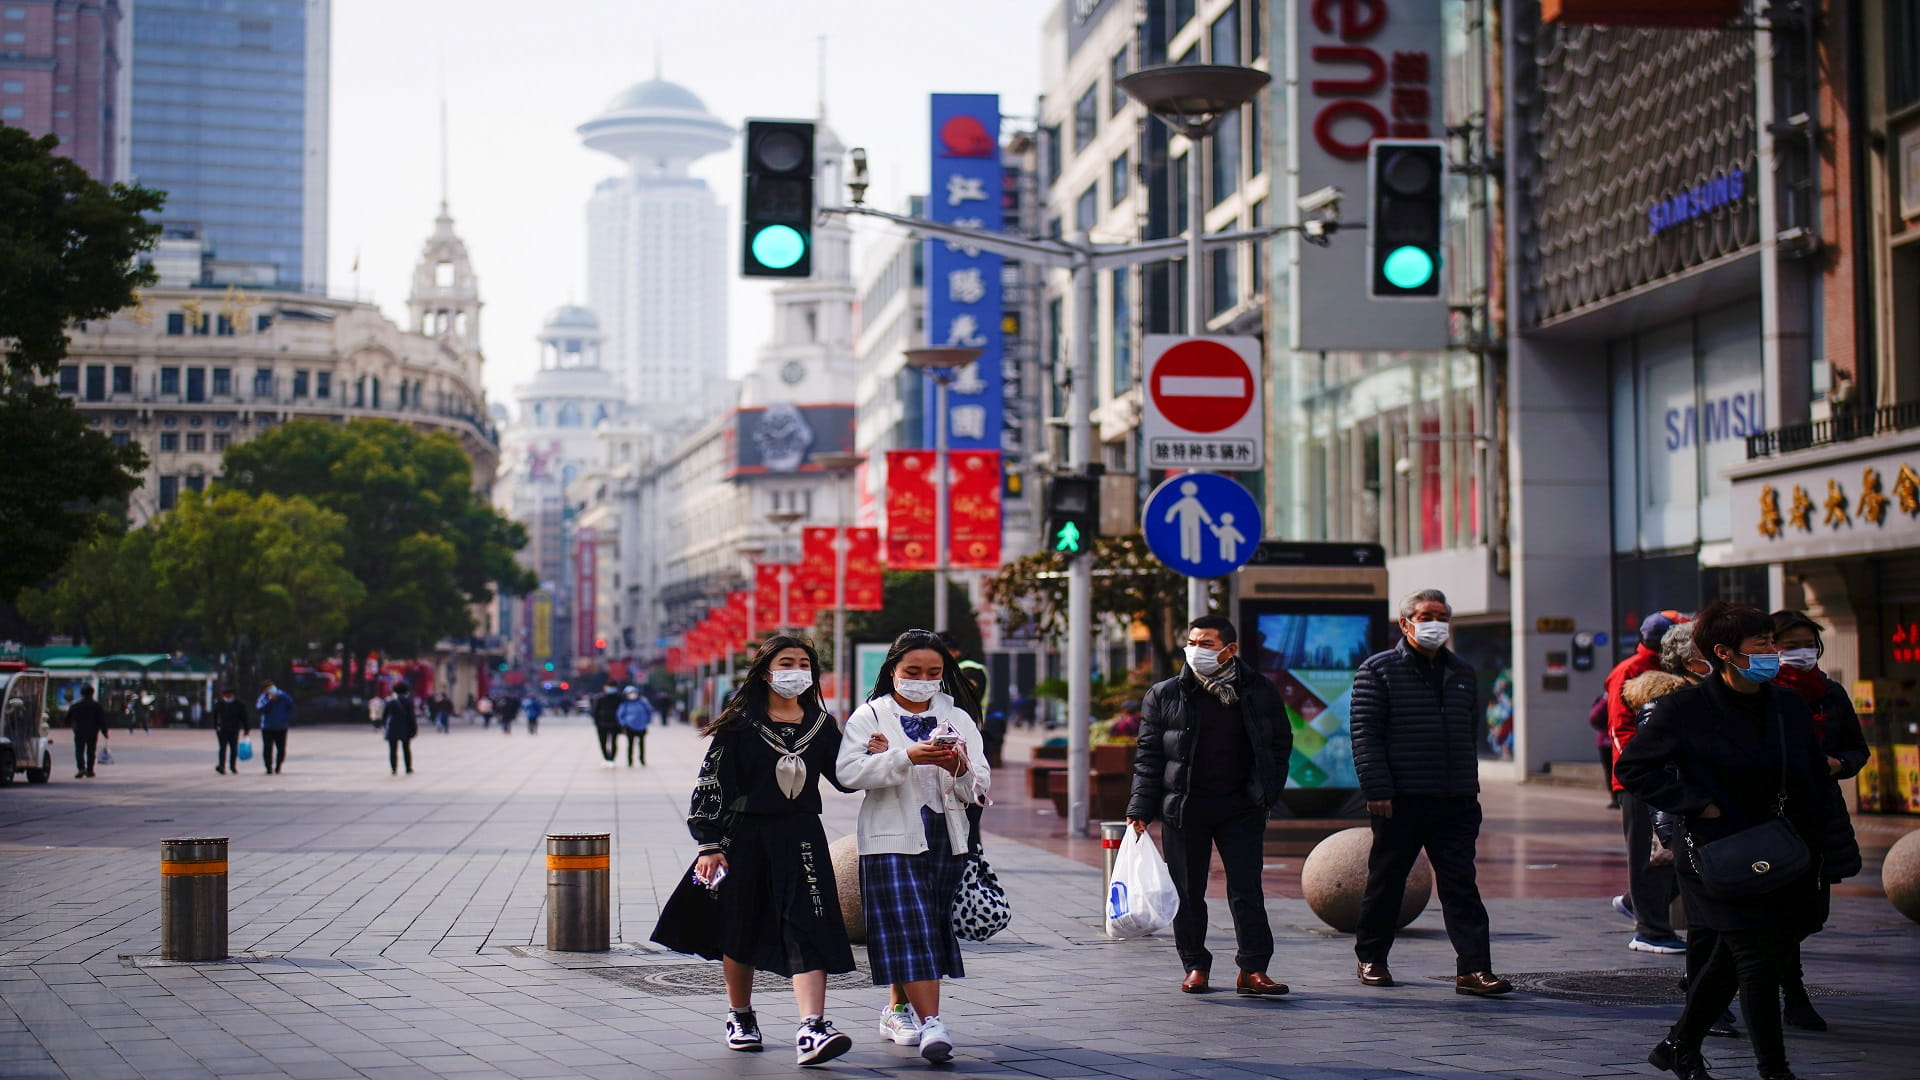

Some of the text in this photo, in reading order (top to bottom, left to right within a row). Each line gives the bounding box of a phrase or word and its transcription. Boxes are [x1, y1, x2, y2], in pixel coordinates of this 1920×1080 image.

[1649, 169, 1744, 236] SAMSUNG
[1154, 442, 1250, 460] 除特种车辆外
